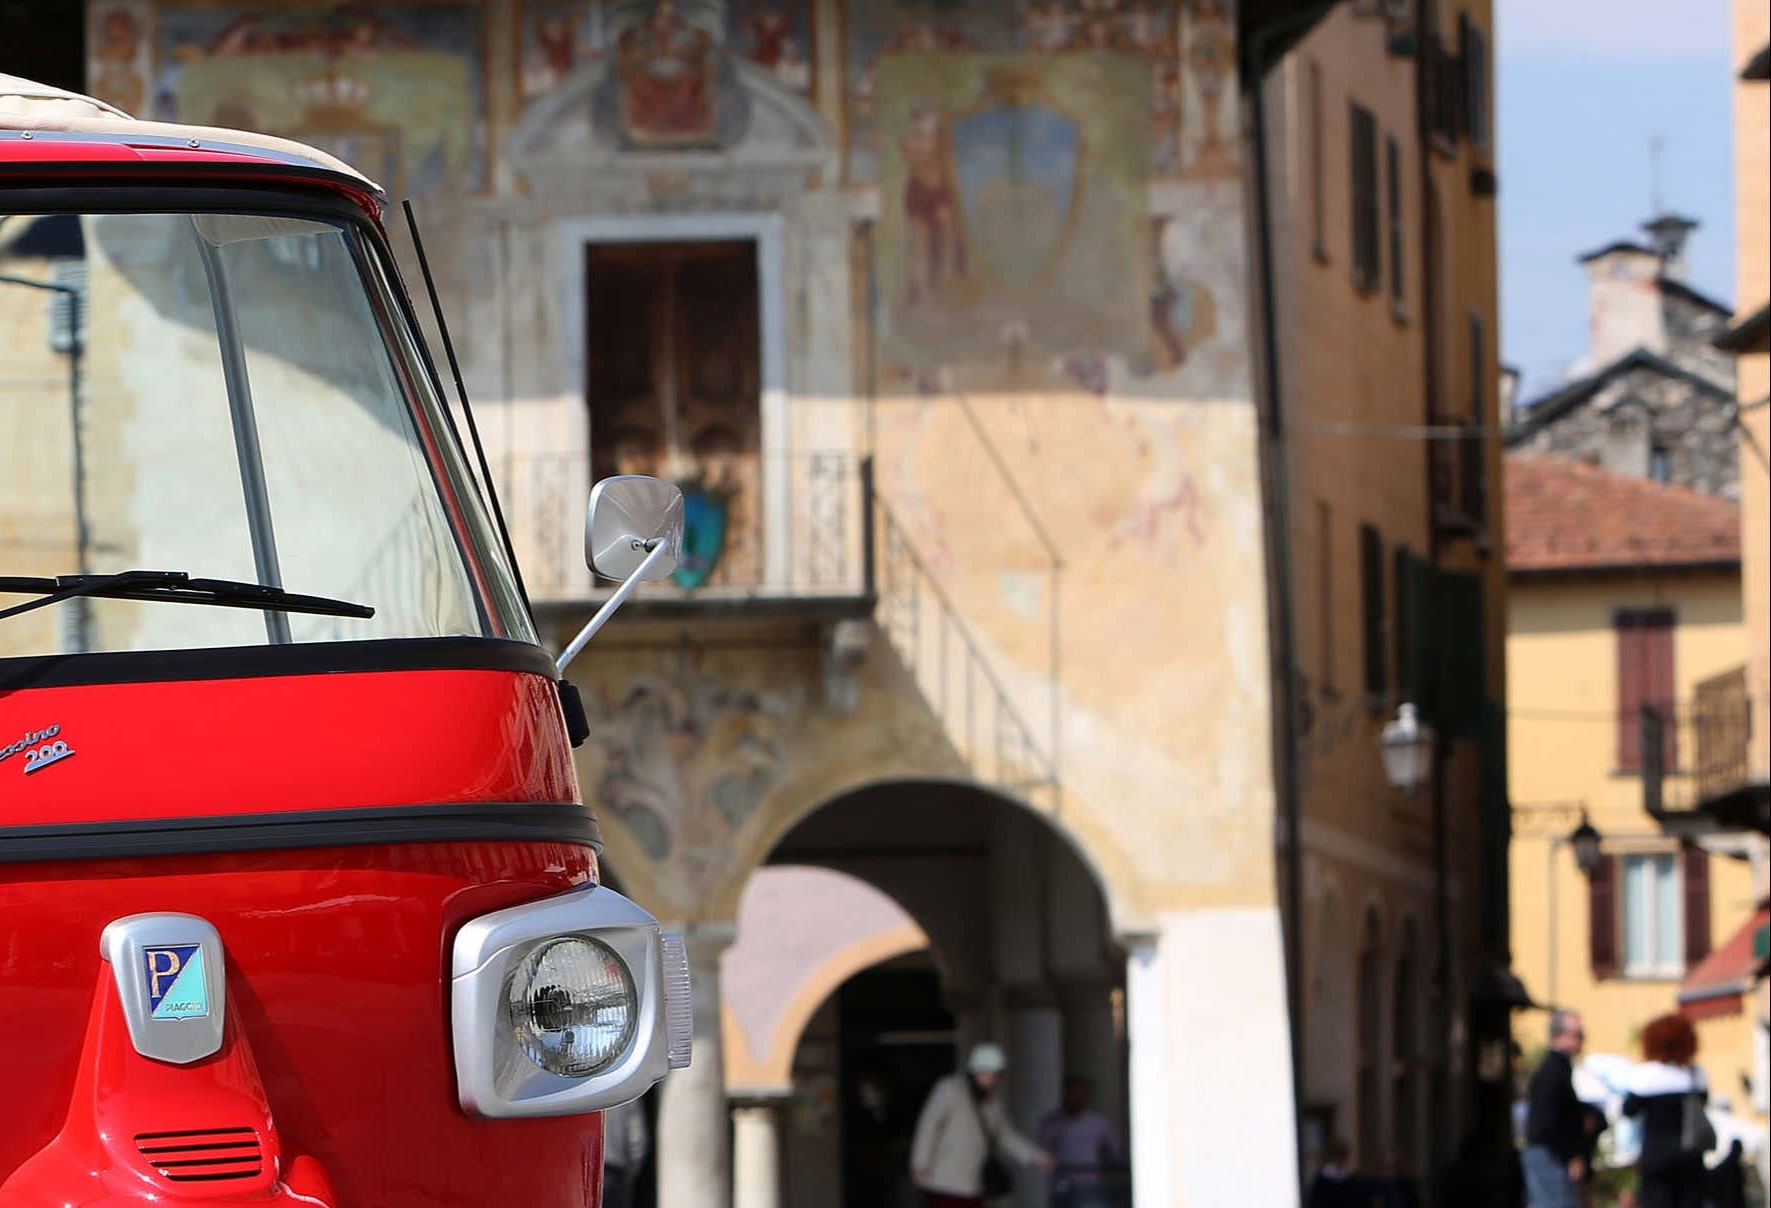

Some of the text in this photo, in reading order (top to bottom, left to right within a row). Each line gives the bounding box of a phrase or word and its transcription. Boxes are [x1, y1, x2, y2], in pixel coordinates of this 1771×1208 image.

[24, 740, 73, 773] 200
[146, 951, 180, 998] P
[166, 1002, 202, 1011] PIAGGIO
